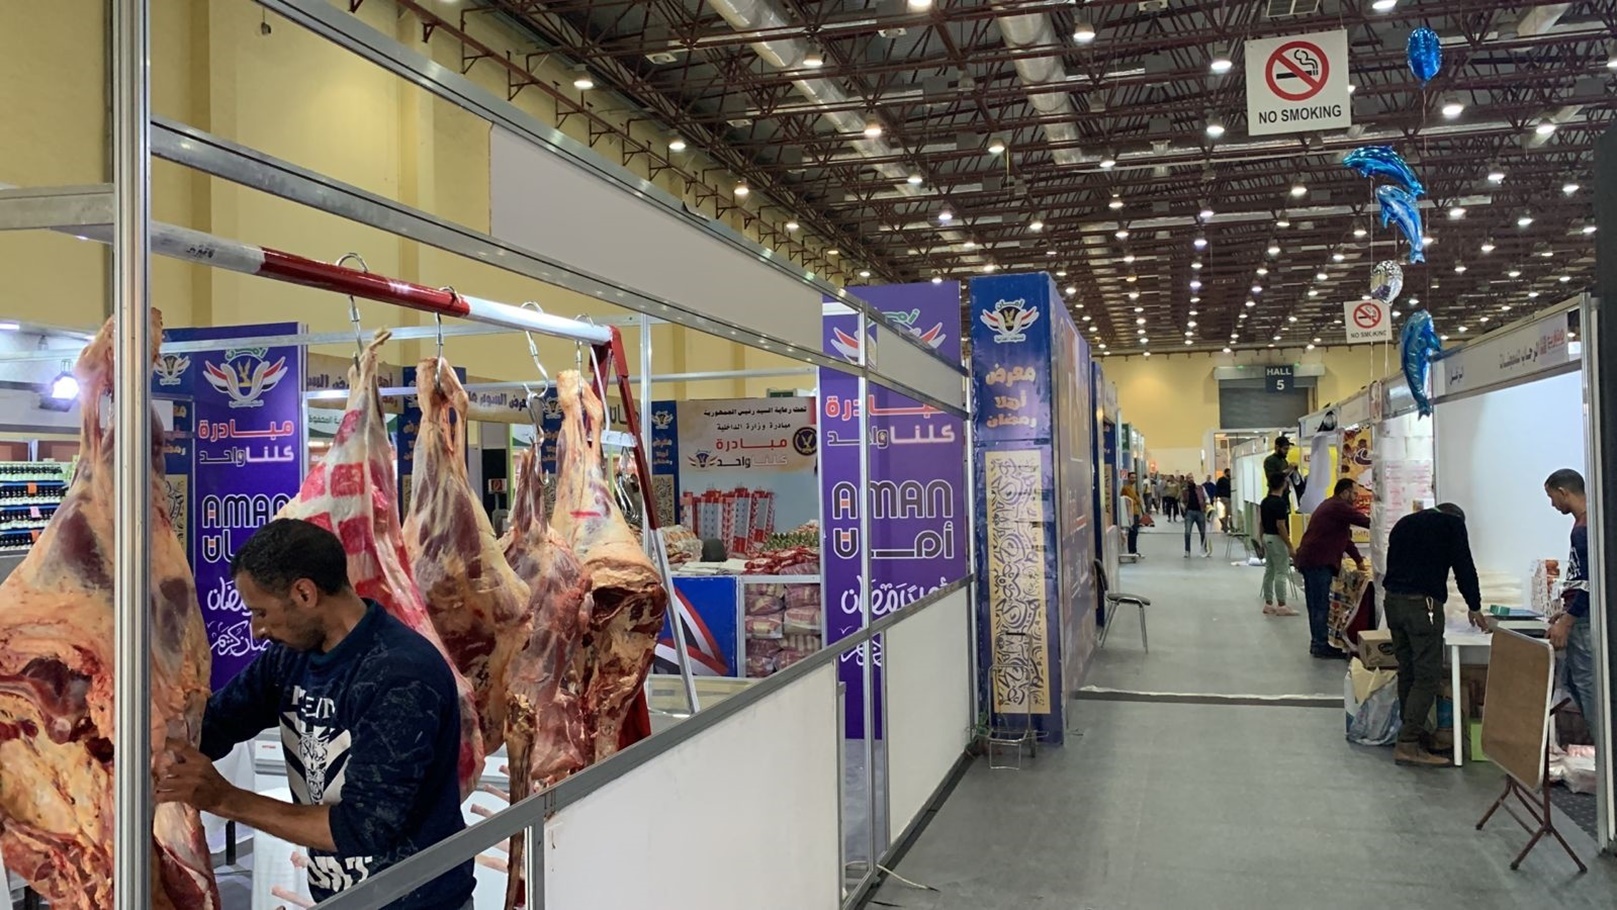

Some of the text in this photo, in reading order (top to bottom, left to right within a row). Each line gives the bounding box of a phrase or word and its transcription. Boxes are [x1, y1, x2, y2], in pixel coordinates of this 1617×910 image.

[1258, 104, 1342, 123] NO SMOKING
[985, 363, 1036, 387] معرض
[1266, 368, 1292, 376] HALL
[1276, 379, 1285, 391] 5
[703, 408, 737, 418] الجمهورية
[738, 408, 755, 417] رئيس
[774, 406, 792, 415] رعاية
[792, 405, 807, 413] تحت
[986, 413, 1037, 428] رمضان
[198, 418, 295, 443] مبادرة
[716, 422, 791, 432] مبادرة وزارة الداخلية
[889, 424, 955, 444] كلنا
[716, 438, 787, 451] مبادرة
[245, 445, 295, 463] كلنا
[717, 456, 751, 468] واحد
[832, 479, 954, 520] AMAN
